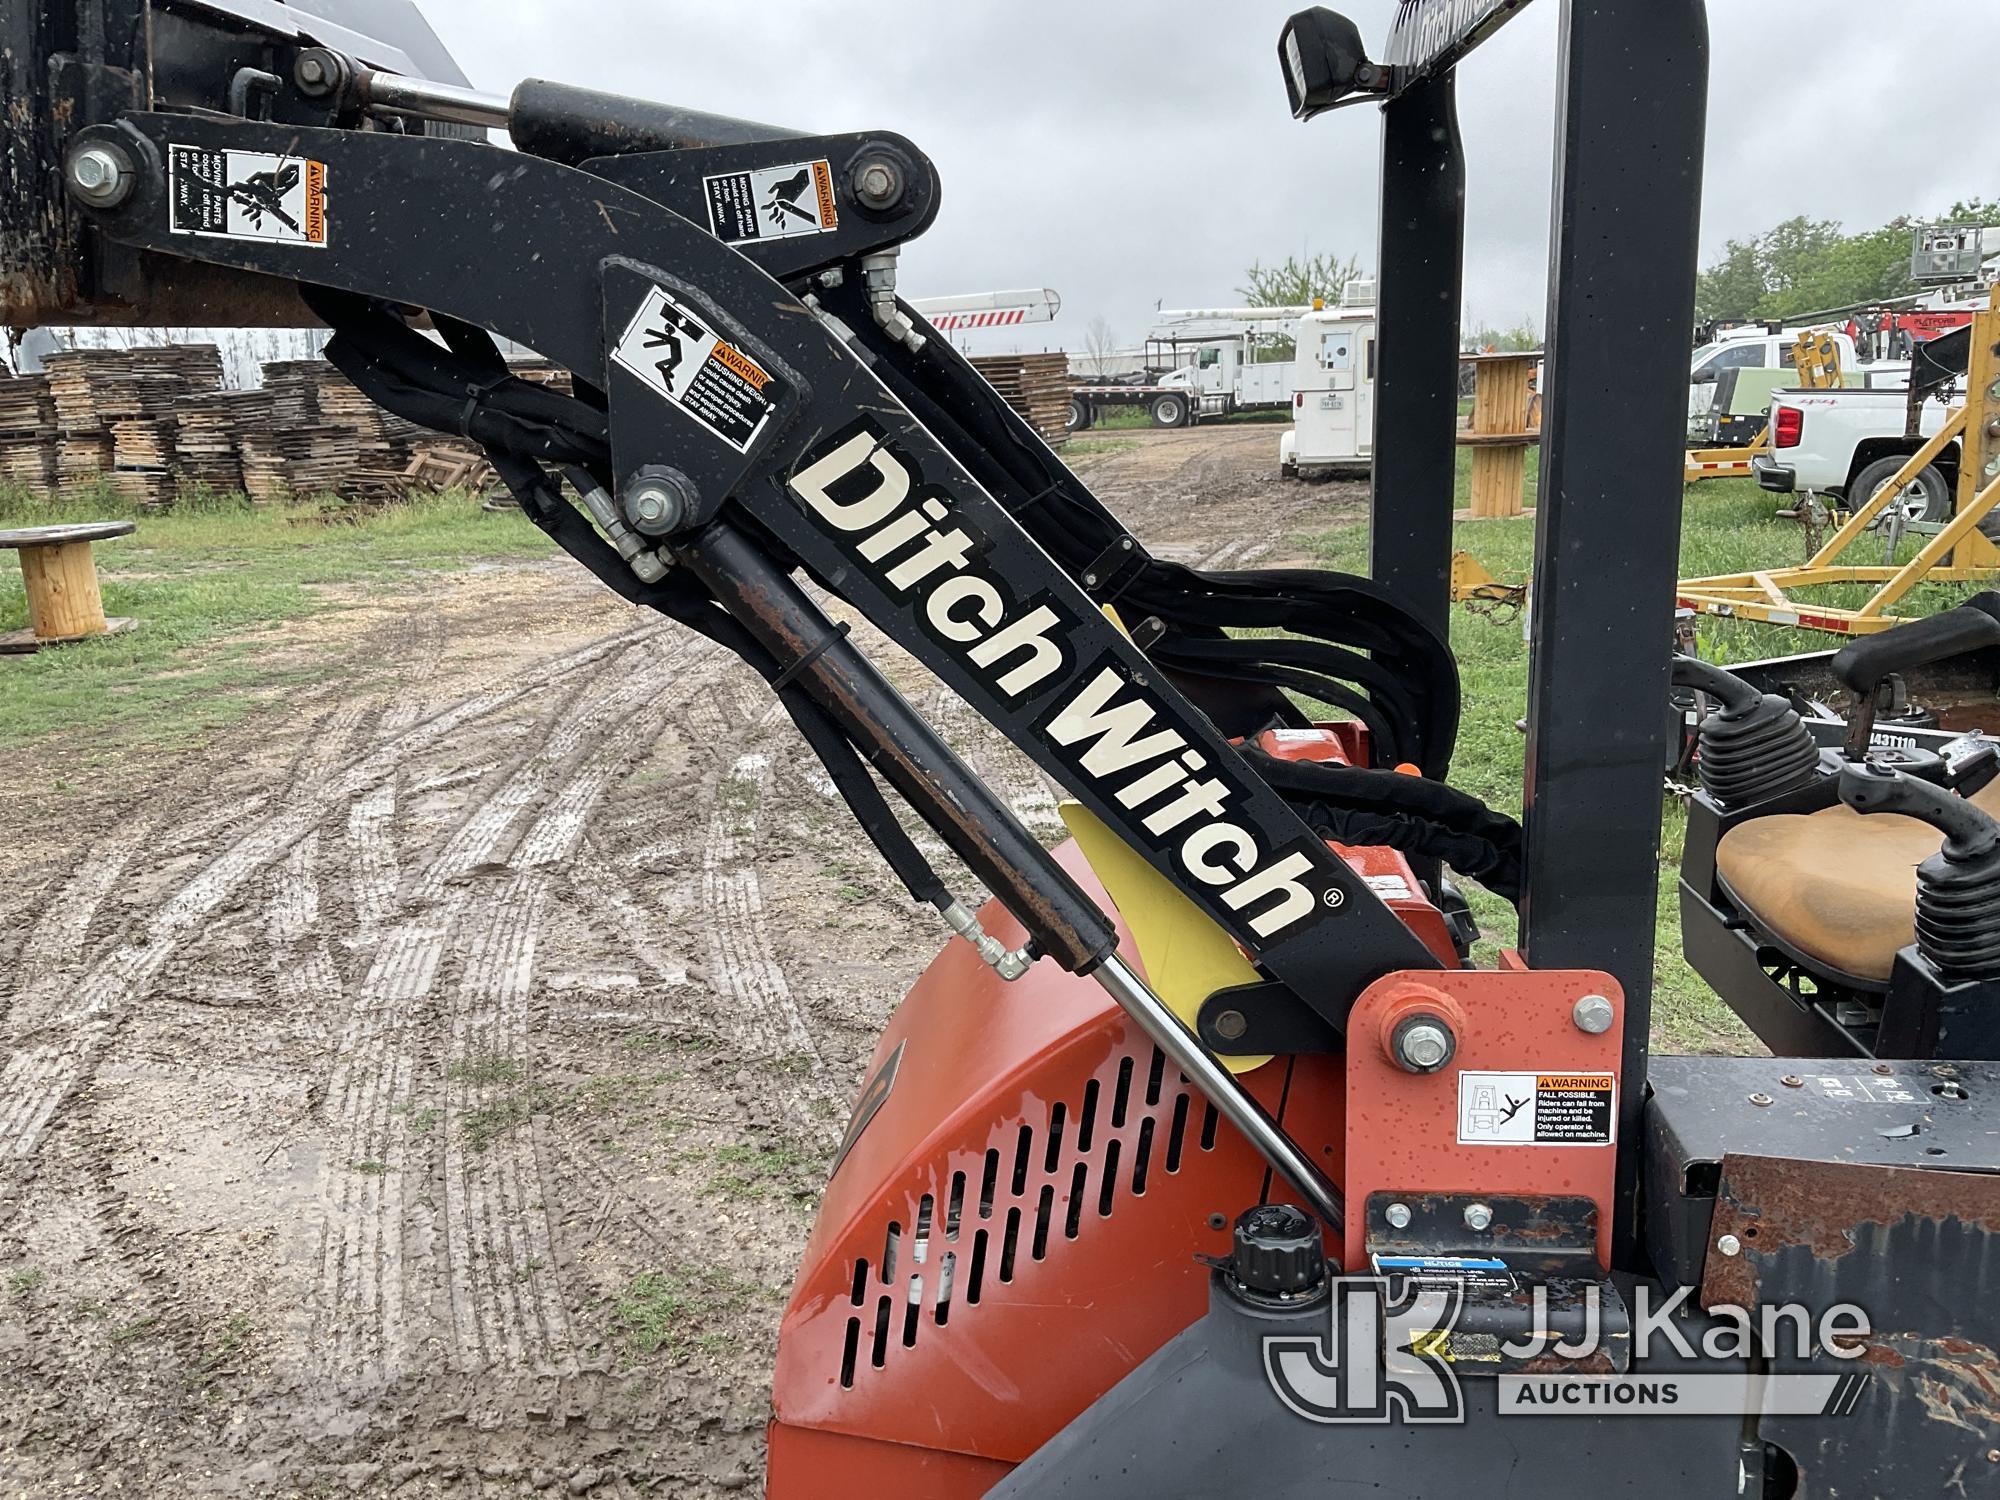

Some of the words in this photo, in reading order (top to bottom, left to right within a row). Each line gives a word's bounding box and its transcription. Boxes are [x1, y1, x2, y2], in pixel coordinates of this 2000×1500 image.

[1417, 0, 1452, 67] Ditch
[180, 152, 188, 168] STA
[192, 152, 198, 162] or
[202, 154, 210, 177] could
[213, 155, 222, 188] MOVIN
[202, 194, 210, 206] off
[713, 181, 721, 200] STAY
[740, 177, 750, 206] MOVING
[745, 209, 754, 232] PARTS
[816, 177, 833, 226] WARNING
[213, 195, 222, 224] PARTS
[310, 178, 320, 239] WARNING
[716, 202, 726, 226] AWAY.
[730, 178, 740, 197] could
[738, 220, 746, 237] hand
[708, 358, 744, 387] CRUSHING
[727, 351, 766, 386] WARNIN
[704, 366, 720, 380] could
[719, 378, 736, 393] cause
[736, 390, 752, 404] death
[705, 380, 726, 396] serious
[684, 395, 700, 408] STAY
[689, 388, 701, 399] and
[700, 396, 730, 420] equipment
[694, 380, 706, 392] Use
[705, 390, 724, 406] proper
[723, 404, 754, 428] procedures
[790, 430, 1062, 696] Ditch
[1046, 666, 1316, 938] Witch
[1552, 1078, 1609, 1088] WARNING
